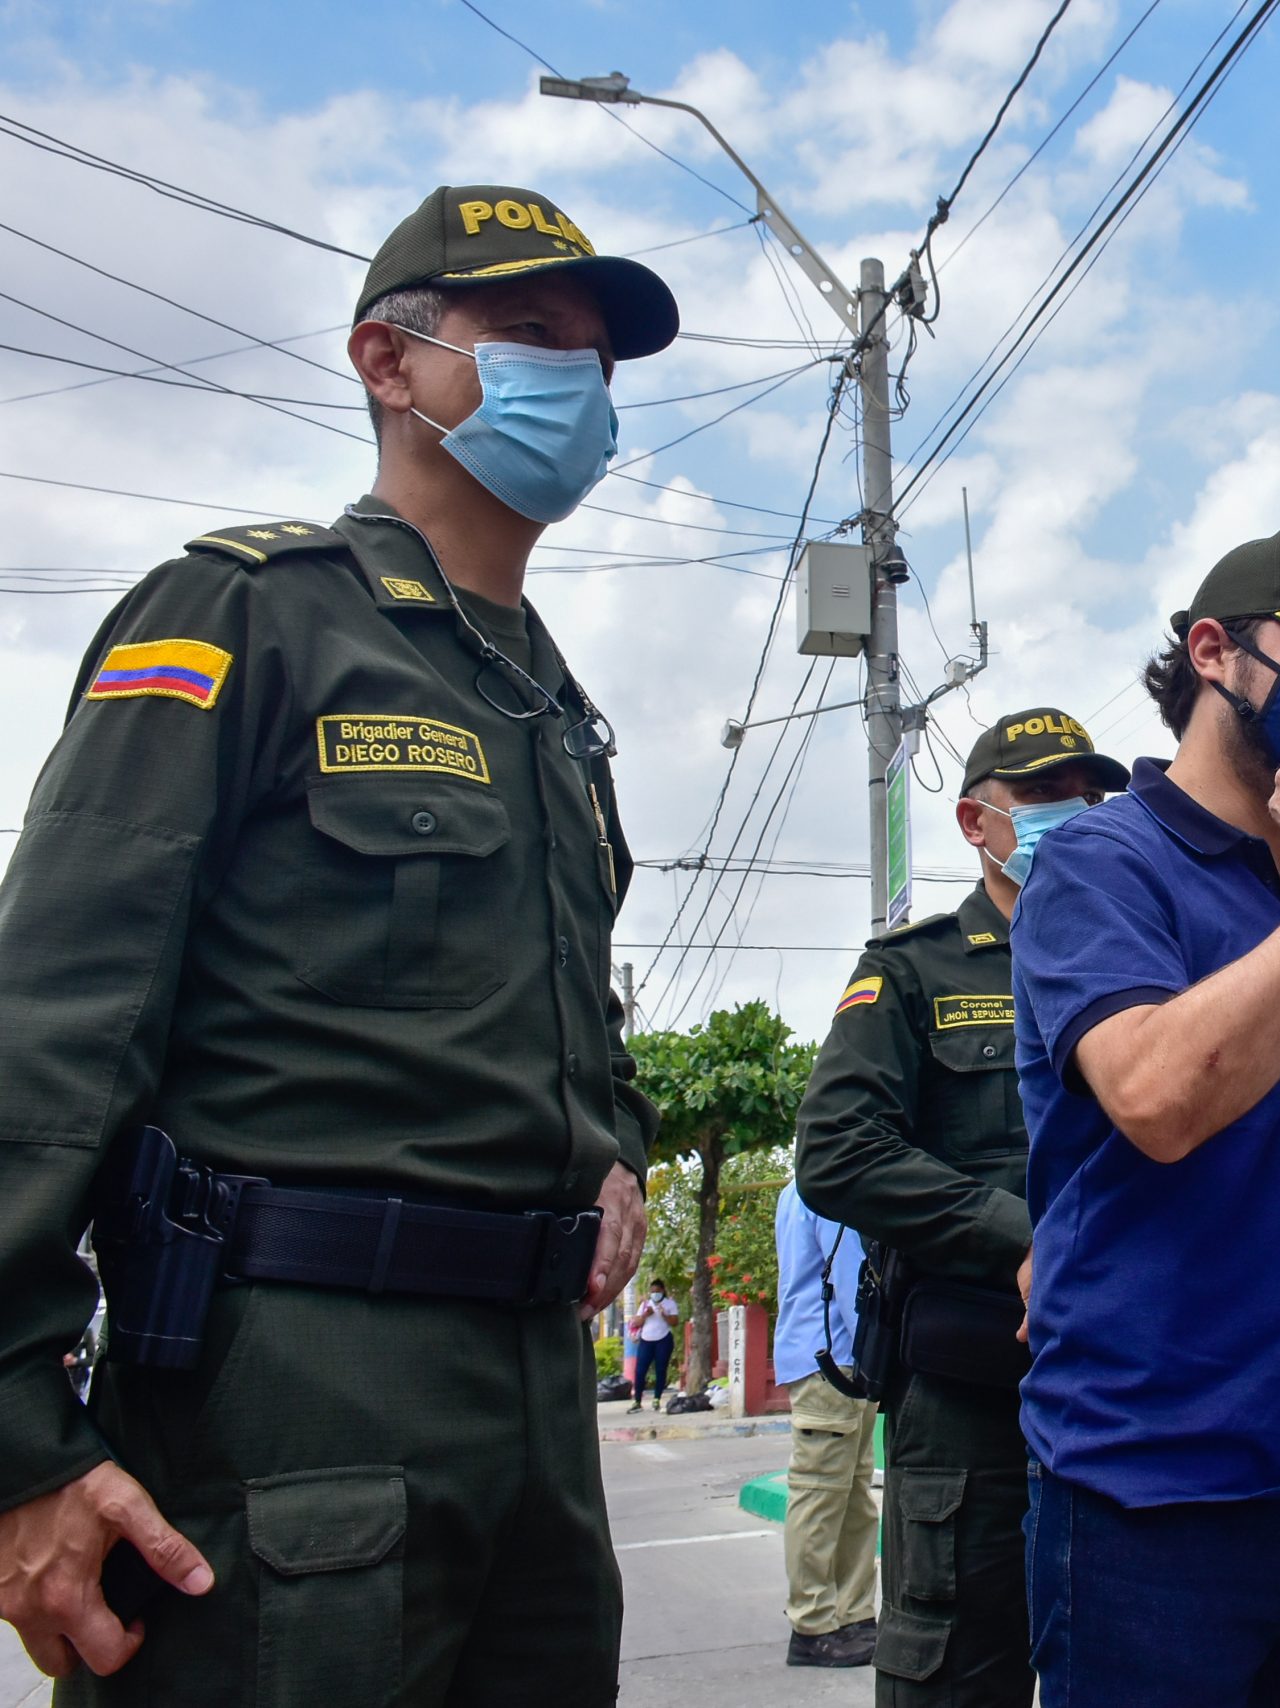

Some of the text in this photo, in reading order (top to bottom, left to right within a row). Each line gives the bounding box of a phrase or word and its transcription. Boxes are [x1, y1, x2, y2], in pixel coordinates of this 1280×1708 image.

[340, 721, 469, 750] Brigadier General
[335, 743, 476, 773] DIEGO ROSERO
[960, 1000, 1003, 1009] Coronel
[943, 1010, 969, 1022] JHON
